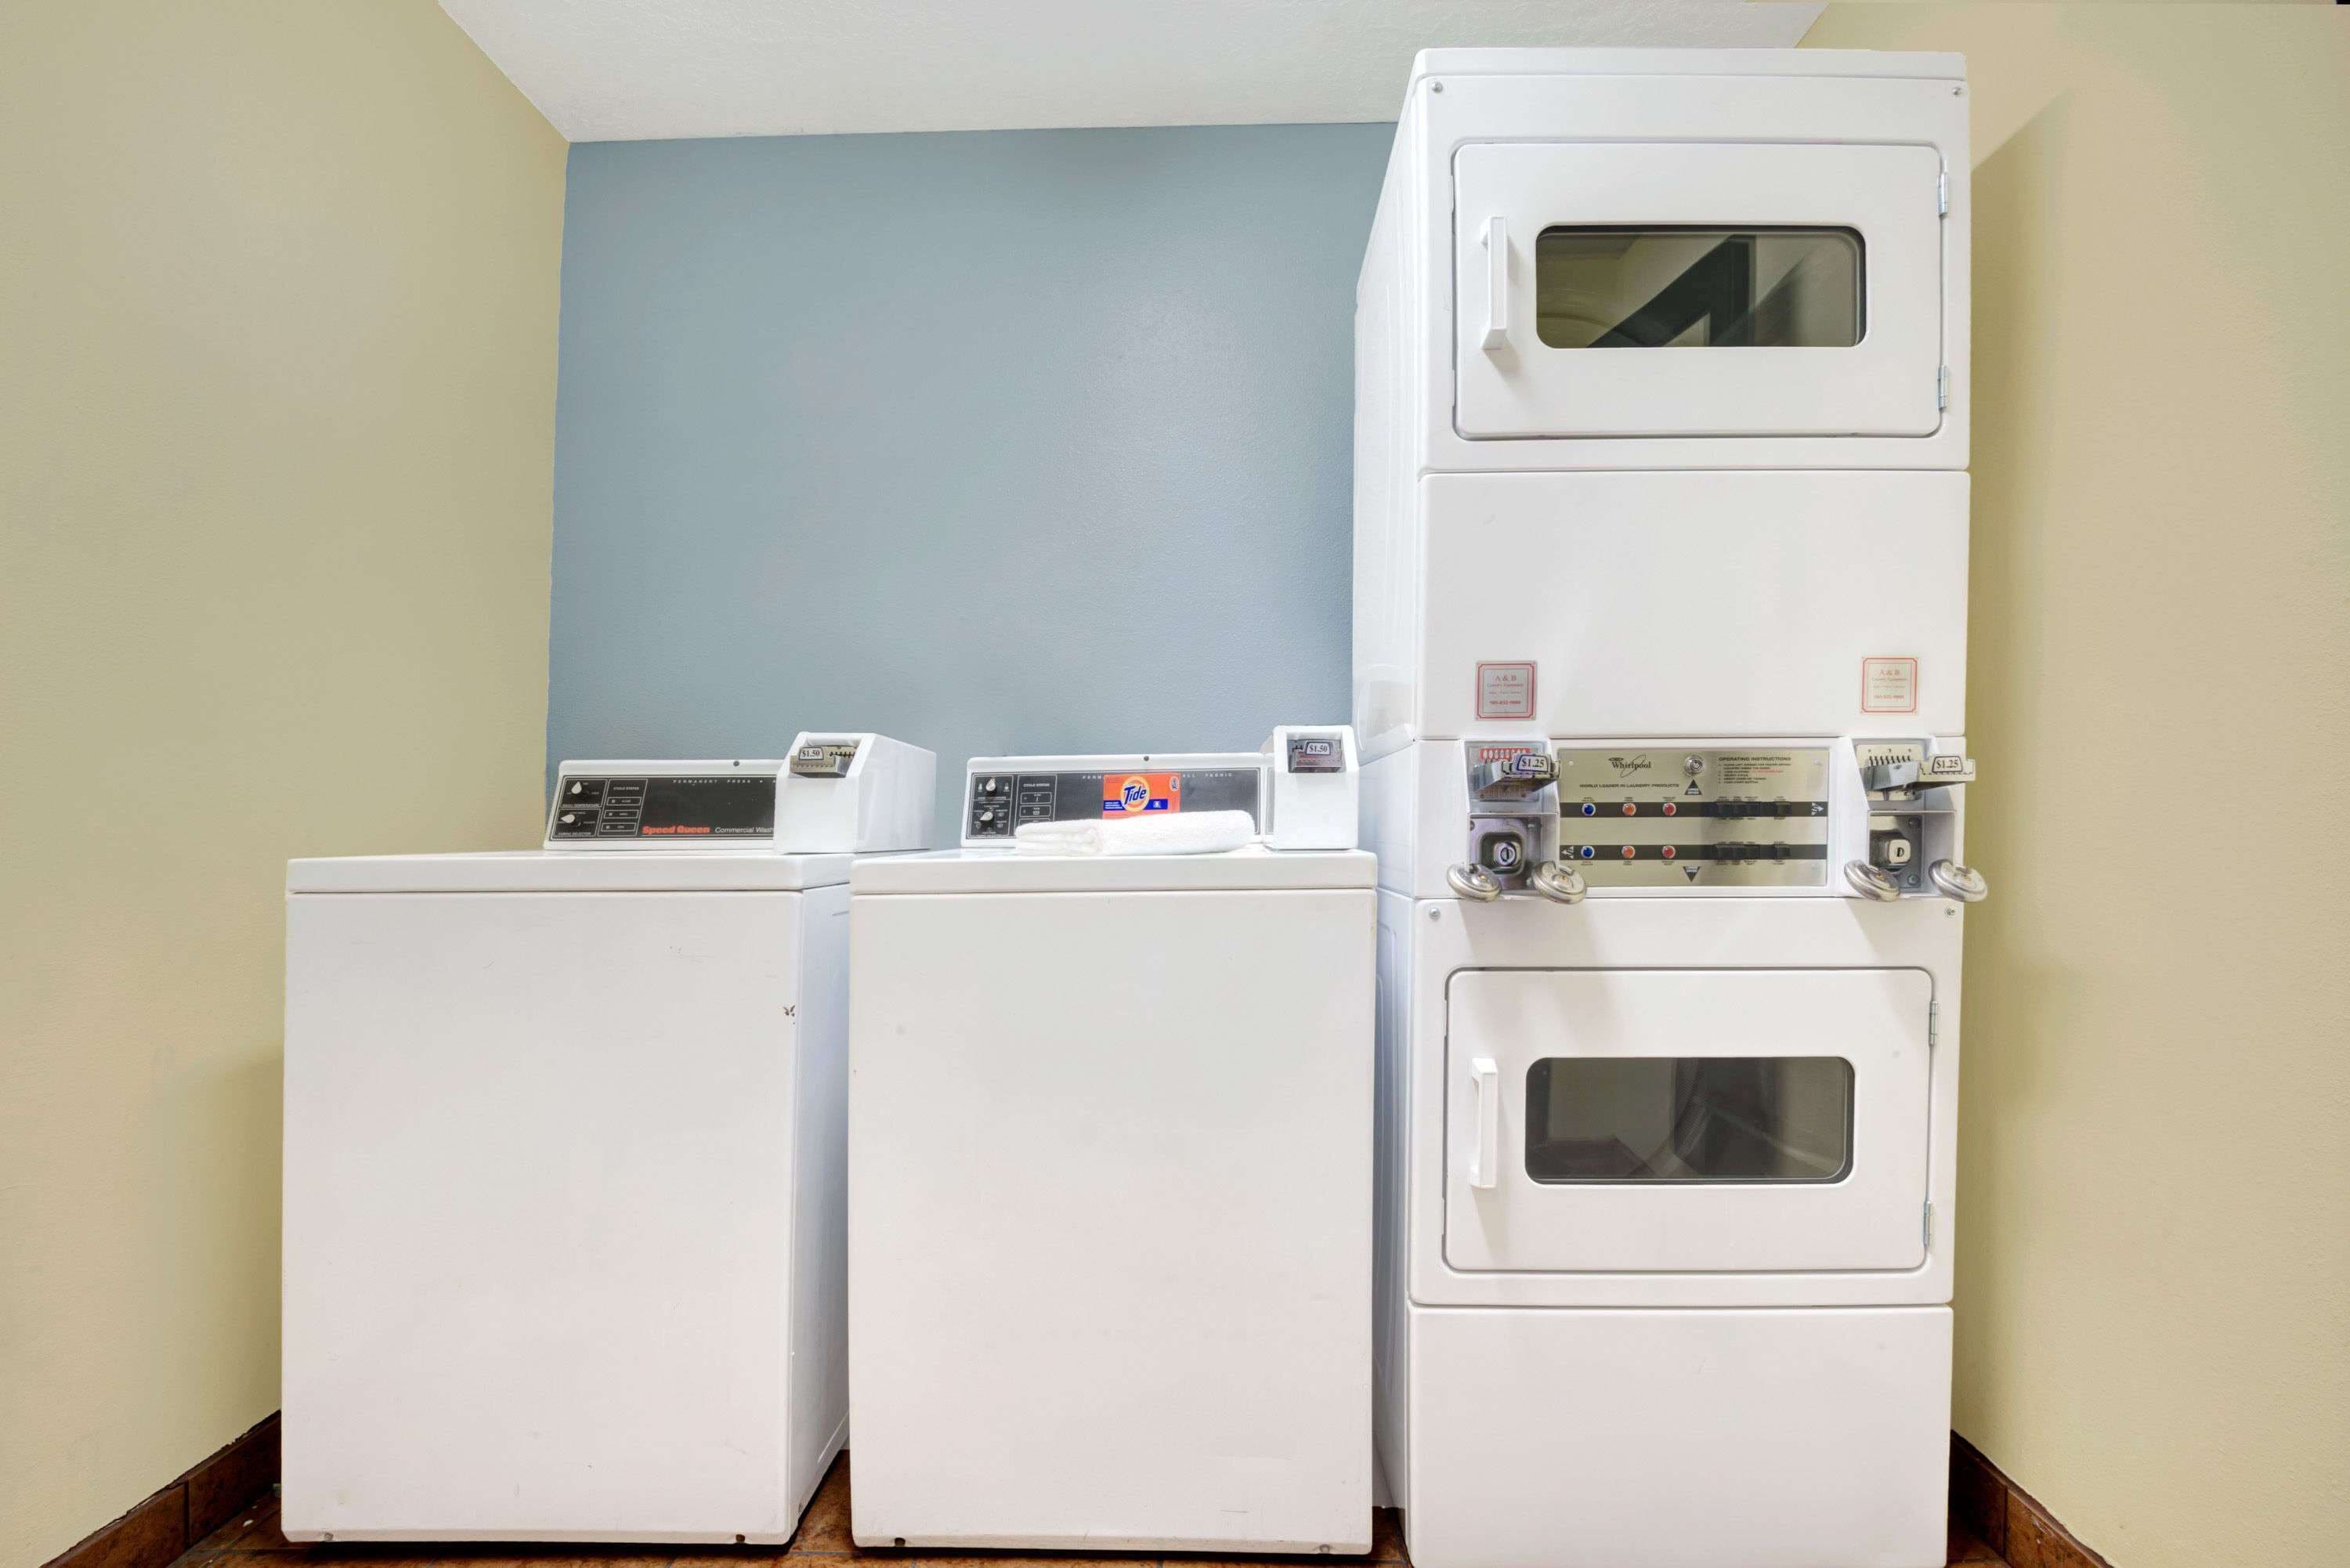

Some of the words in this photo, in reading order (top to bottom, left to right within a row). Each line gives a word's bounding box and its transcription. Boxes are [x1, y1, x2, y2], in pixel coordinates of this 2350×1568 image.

[1521, 758, 1545, 768] $1.25
[1612, 761, 1651, 771] Whirlpool
[1936, 760, 1959, 768] $1.25
[1124, 786, 1147, 805] Tide
[642, 826, 676, 835] Speed
[676, 825, 710, 834] Queen
